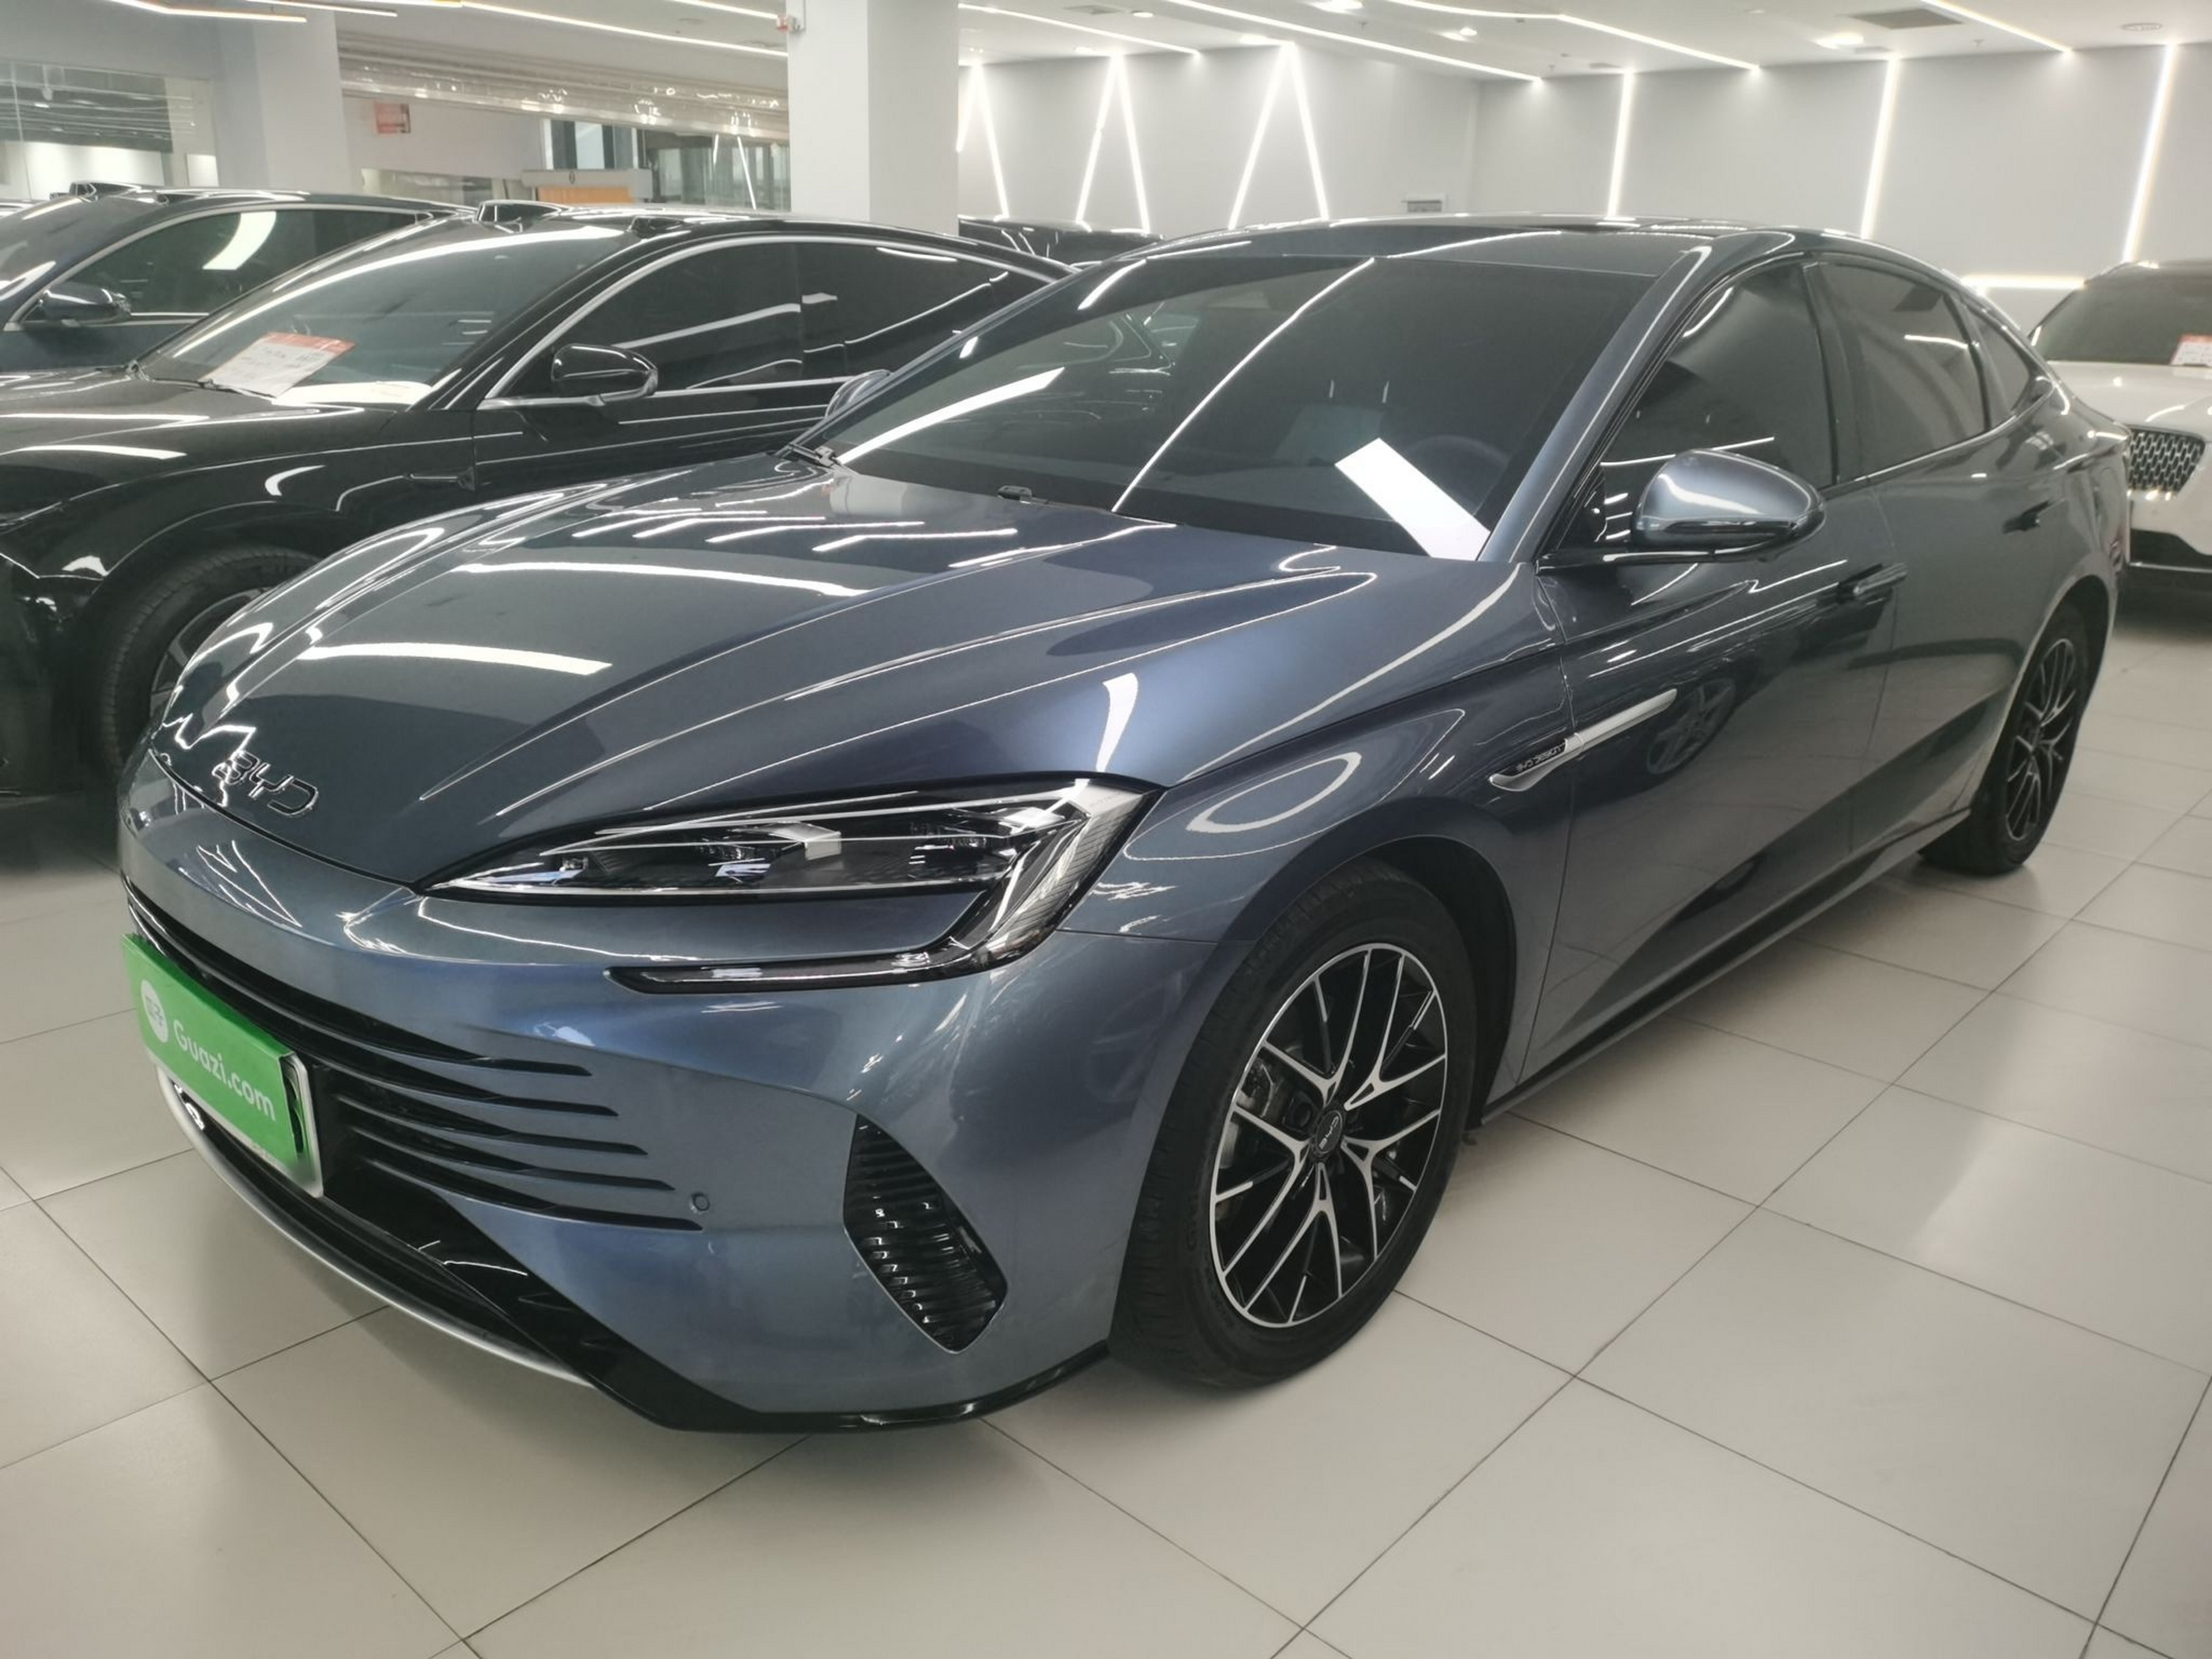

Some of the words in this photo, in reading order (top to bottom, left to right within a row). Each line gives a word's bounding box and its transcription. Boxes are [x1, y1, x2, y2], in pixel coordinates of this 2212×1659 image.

[211, 751, 319, 816] BYD
[173, 1019, 276, 1122] Guazi.com
[1319, 1116, 1339, 1150] BYD
